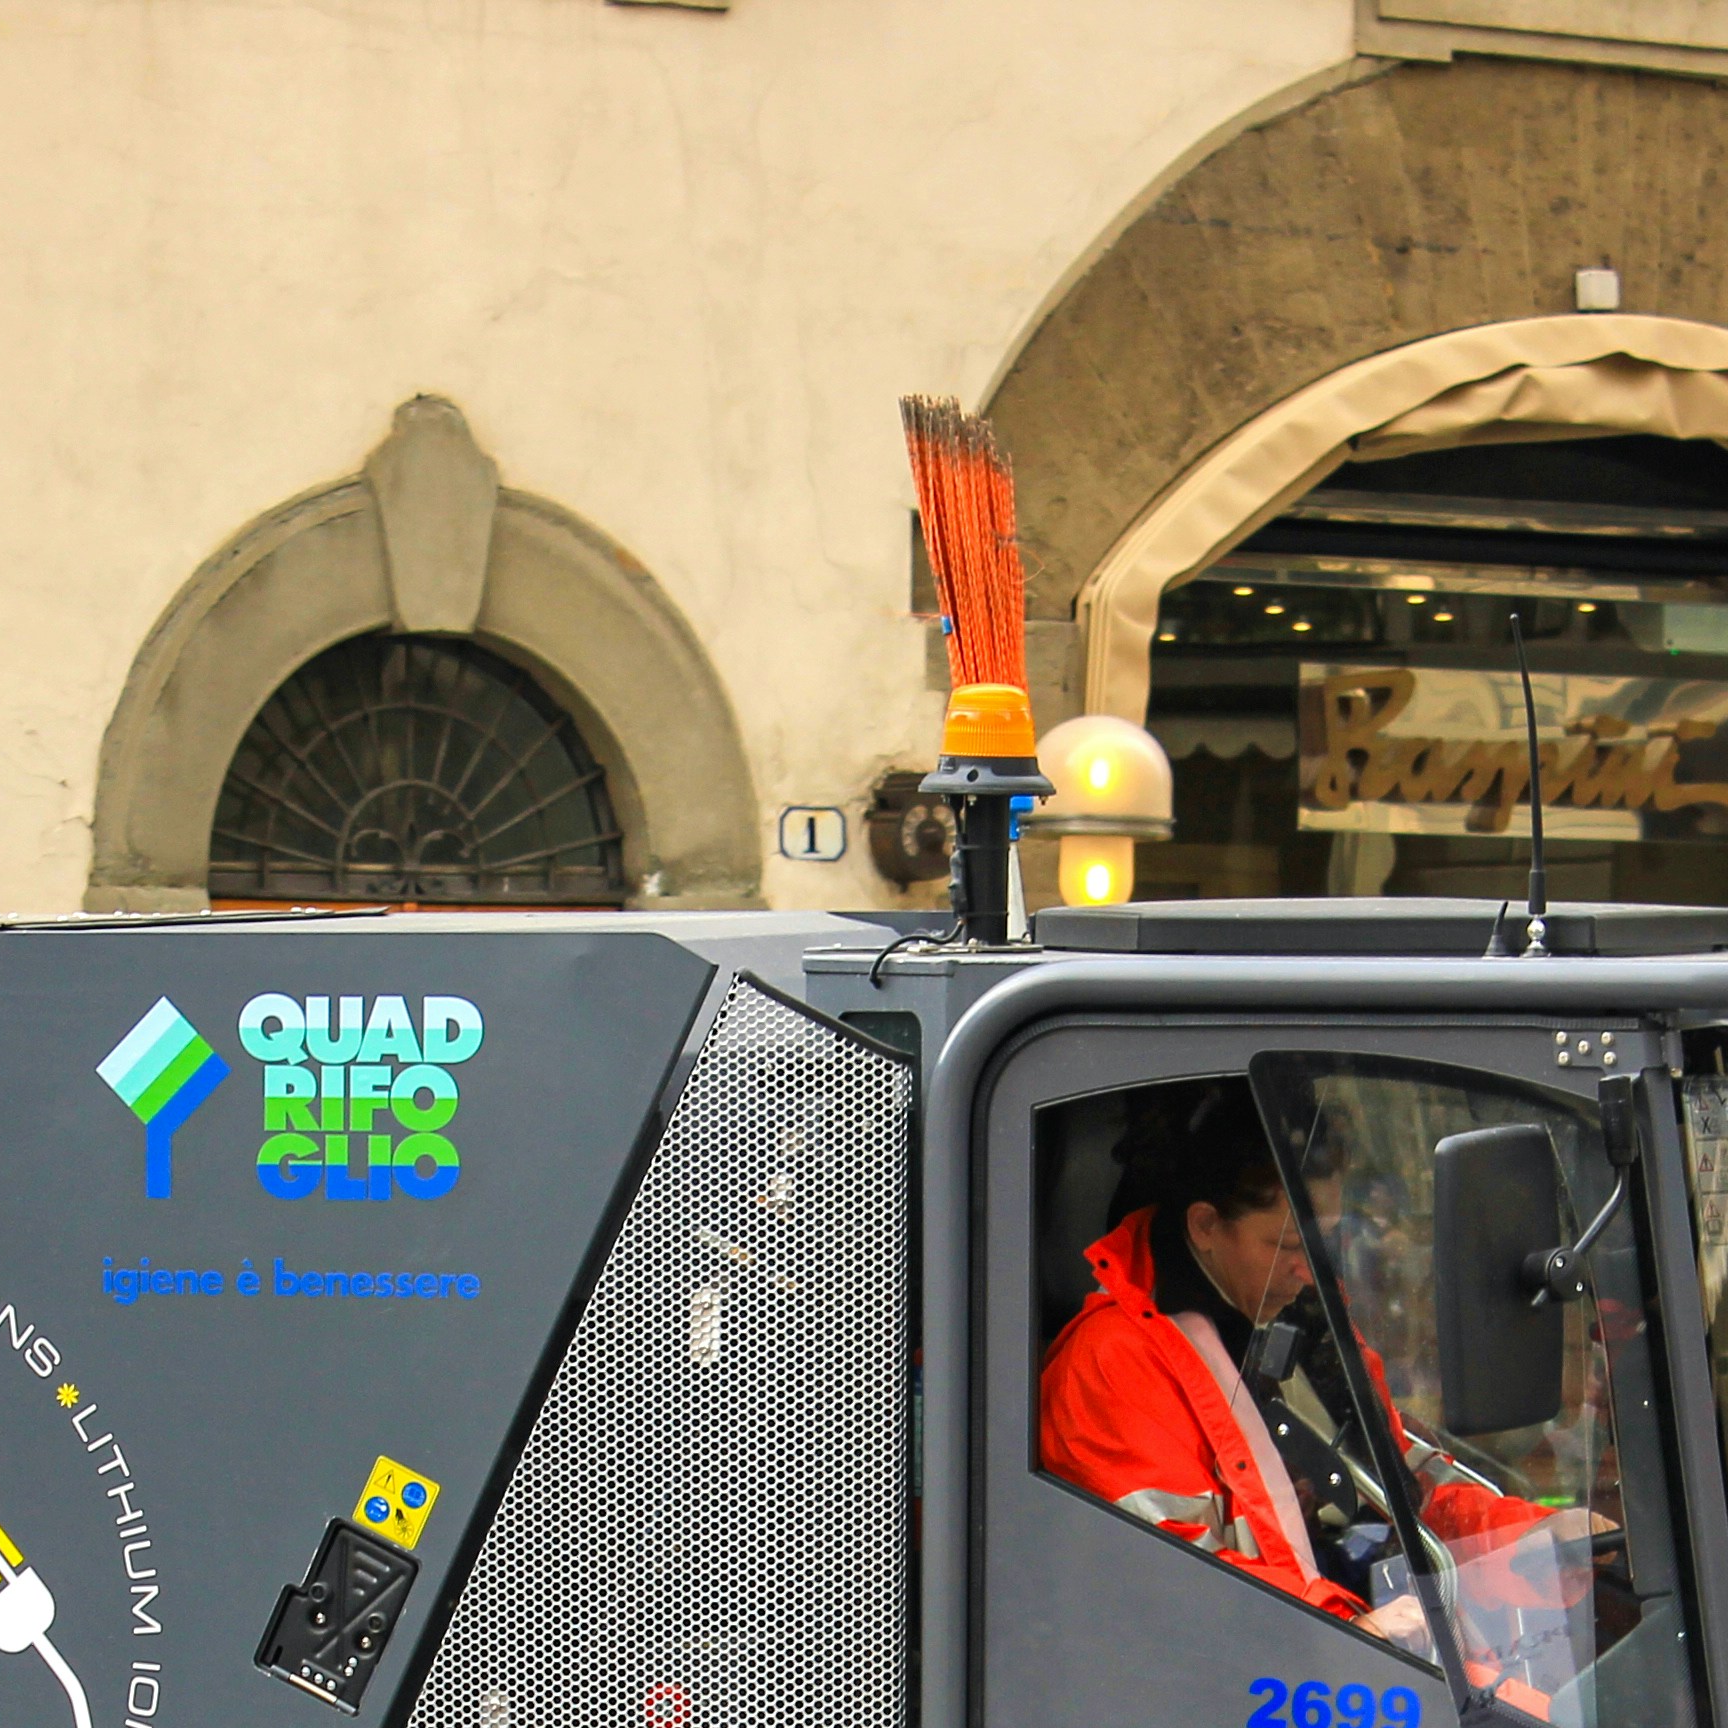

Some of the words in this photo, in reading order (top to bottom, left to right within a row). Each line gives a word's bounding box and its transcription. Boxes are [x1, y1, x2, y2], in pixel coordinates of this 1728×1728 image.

[803, 816, 821, 853] 1
[237, 993, 484, 1066] QUAD
[262, 1063, 459, 1132] RIFO
[256, 1132, 460, 1200] GLIO
[102, 1257, 222, 1305] igiene
[236, 1258, 261, 1297] è
[274, 1257, 481, 1299] benessere
[69, 1402, 162, 1637] LITHIUM
